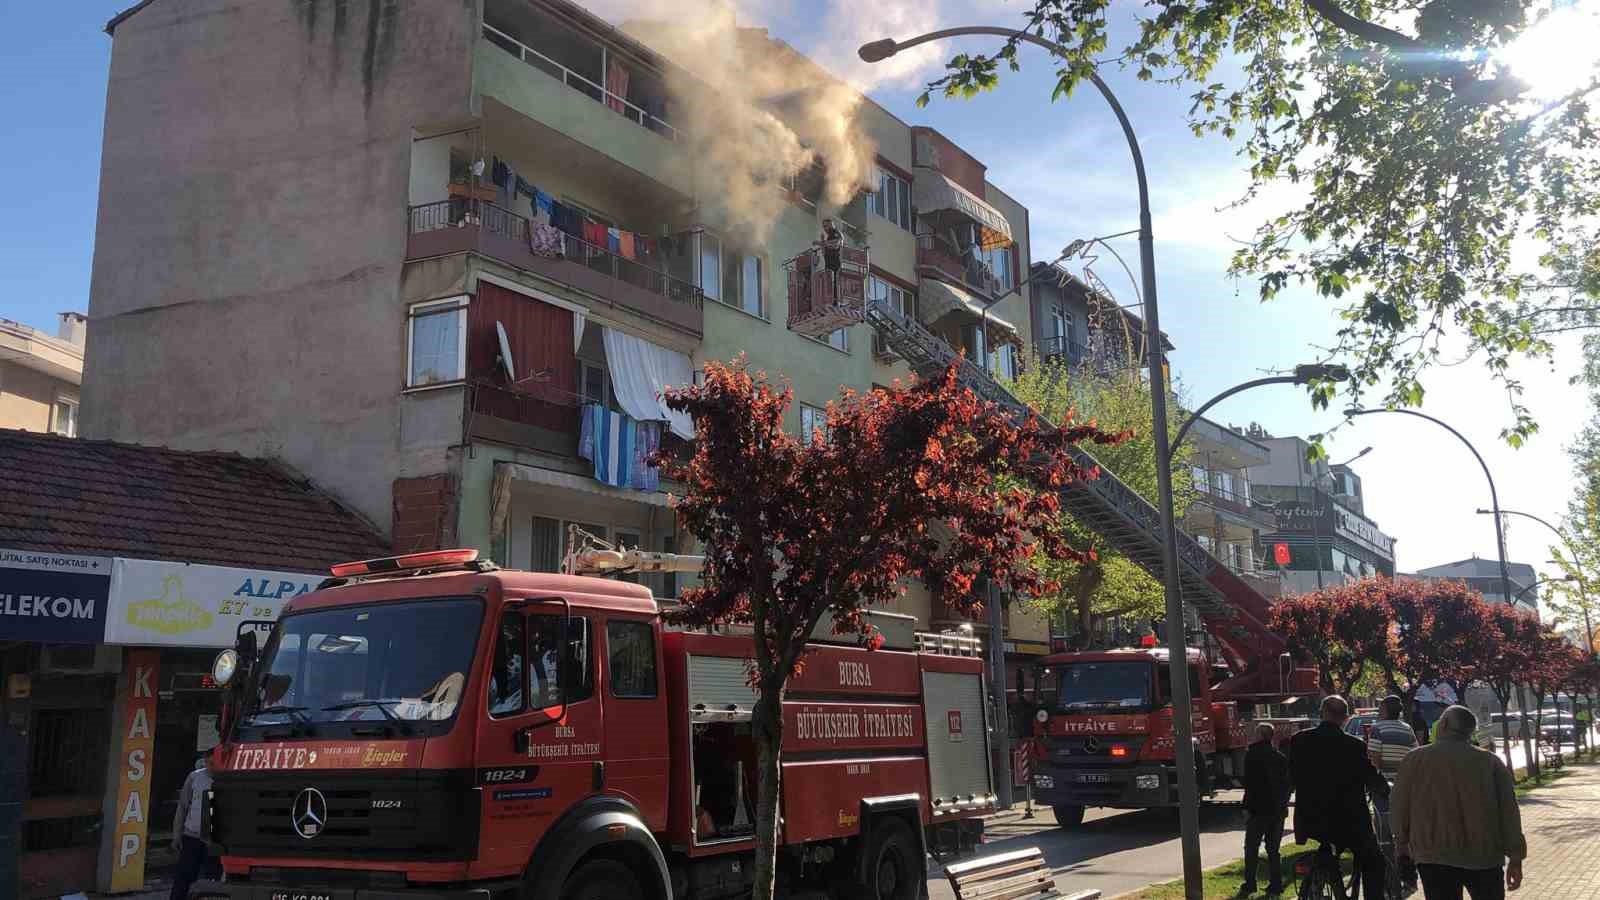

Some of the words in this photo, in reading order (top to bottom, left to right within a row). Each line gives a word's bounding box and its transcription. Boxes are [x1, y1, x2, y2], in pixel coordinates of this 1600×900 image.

[838, 661, 872, 687] BURSA
[797, 707, 860, 743] BÜYÜKŞEHİR
[863, 708, 913, 738] İTFAİYESİ
[120, 666, 152, 867] KASAP
[234, 742, 306, 770] İTFAİYE
[484, 769, 527, 782] 1824
